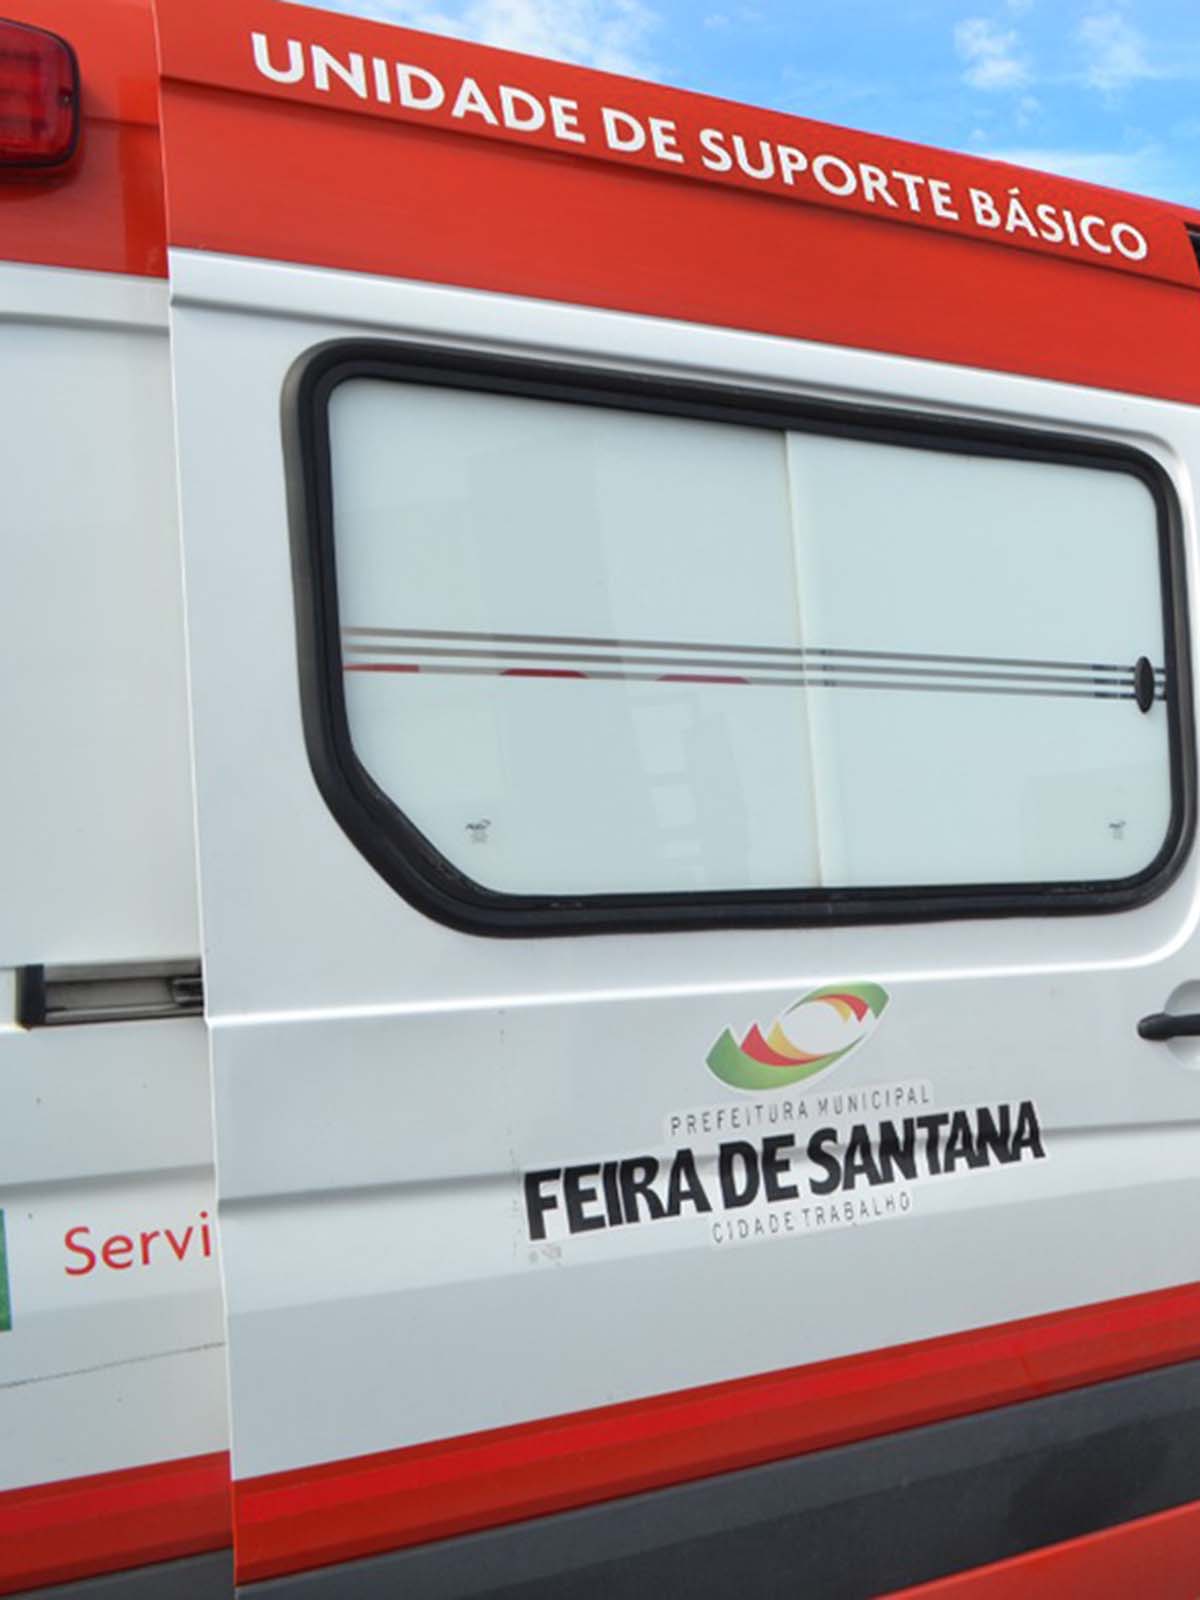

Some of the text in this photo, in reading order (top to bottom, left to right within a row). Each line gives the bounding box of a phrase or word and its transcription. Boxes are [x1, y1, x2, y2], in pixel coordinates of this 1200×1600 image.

[250, 32, 1149, 261] UNIDADE DE SUPORTE BÁSICO
[670, 1085, 932, 1136] PREFEITURA MUNICIPAL
[522, 1099, 1047, 1241] FEIRA DE SANTANA
[63, 1210, 211, 1277] Servi
[711, 1191, 912, 1243] CIDADE TRABALHO
